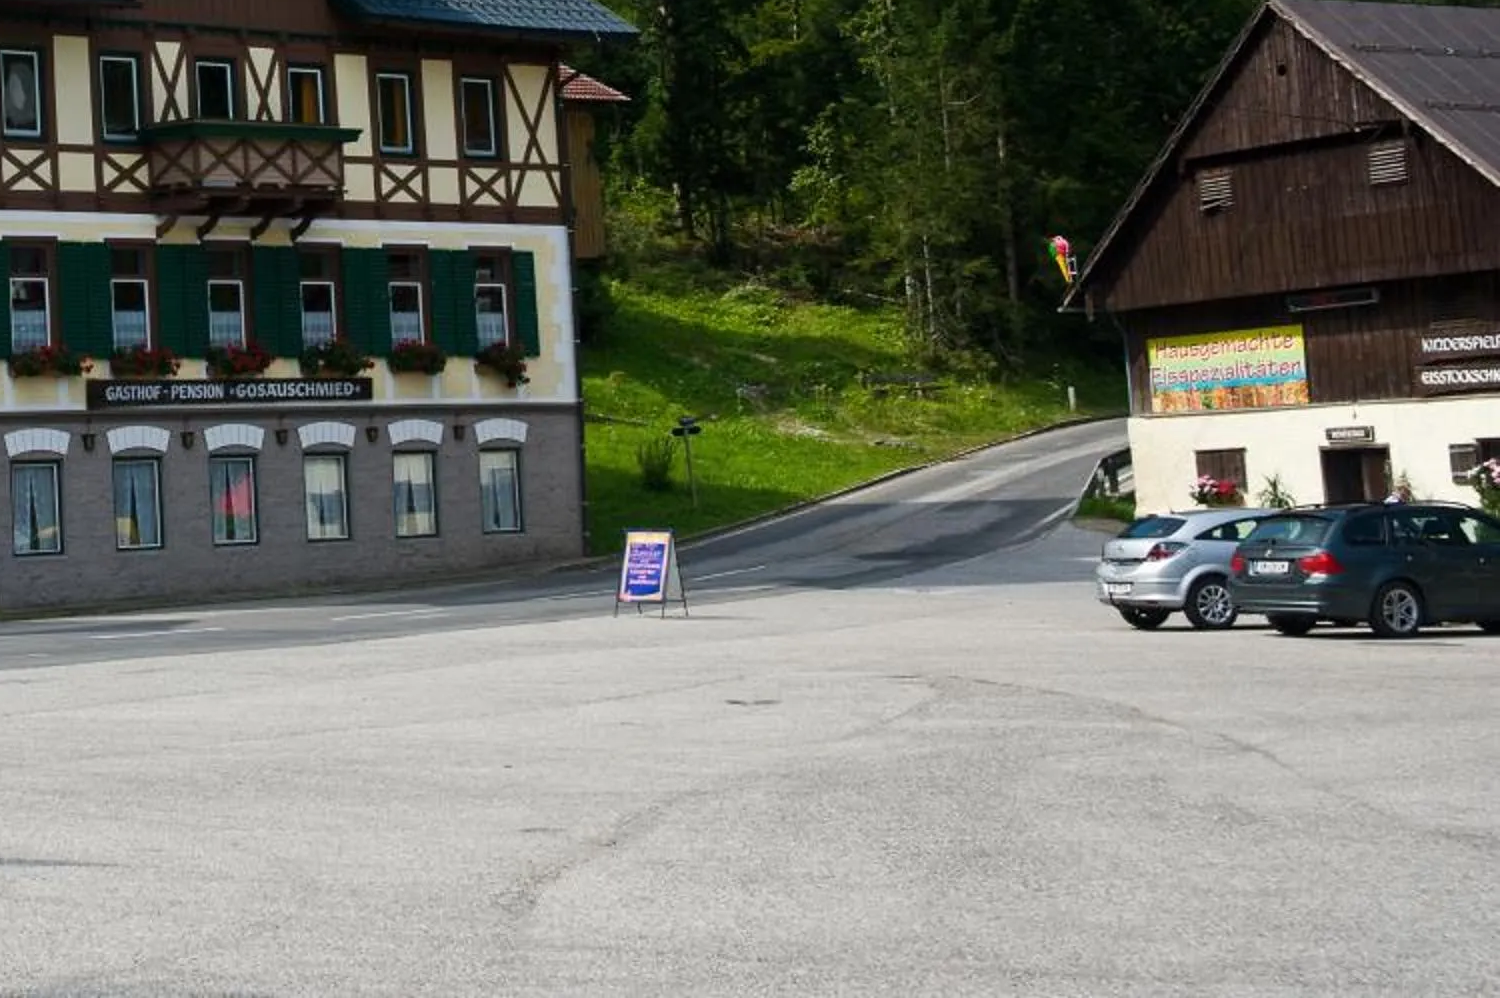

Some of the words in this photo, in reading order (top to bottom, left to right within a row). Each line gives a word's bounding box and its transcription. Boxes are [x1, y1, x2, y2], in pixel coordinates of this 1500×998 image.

[1155, 329, 1294, 361] Hausgemachte
[1152, 357, 1301, 388] Eisspezialitäten
[105, 385, 162, 401] GASTHOF
[171, 383, 224, 399] PENSION
